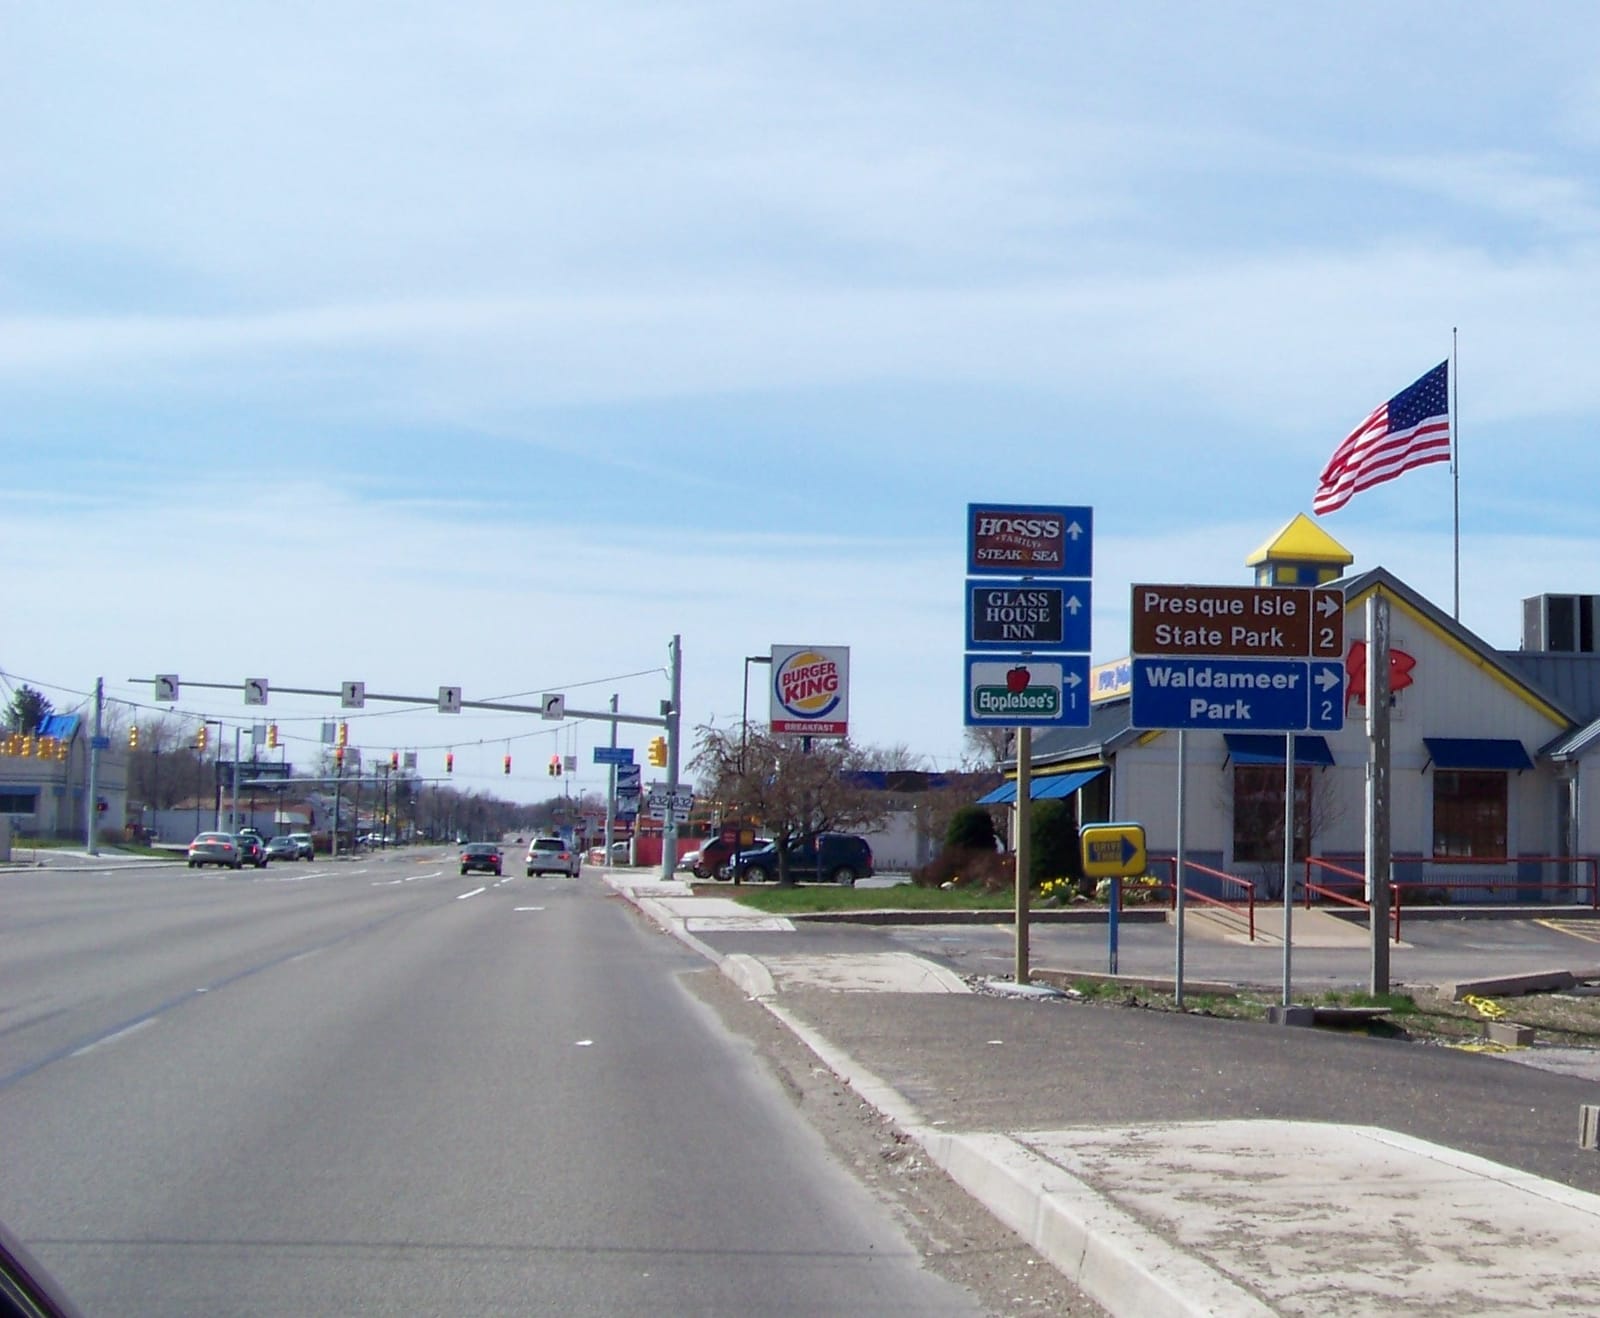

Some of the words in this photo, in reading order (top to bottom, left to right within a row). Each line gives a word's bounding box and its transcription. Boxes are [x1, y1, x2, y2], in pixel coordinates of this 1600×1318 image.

[977, 548, 1022, 560] STEAK
[1031, 550, 1059, 561] SEA
[988, 592, 1048, 607] GLASS
[1144, 592, 1244, 617] Presque
[1254, 595, 1296, 615] Isle
[986, 607, 1050, 622] HOUSE
[1002, 624, 1035, 638] INN
[1155, 624, 1222, 646] State
[1231, 626, 1284, 647] Park
[1320, 628, 1334, 648] 2
[783, 662, 836, 686] BURGER
[1146, 667, 1300, 689] Waldameer
[785, 674, 838, 704] KING
[980, 692, 1054, 711] Applebee's
[1071, 692, 1076, 709] 1
[1190, 699, 1251, 720] Park
[1321, 701, 1333, 721] 2
[650, 795, 668, 806] 832
[673, 796, 691, 807] 832
